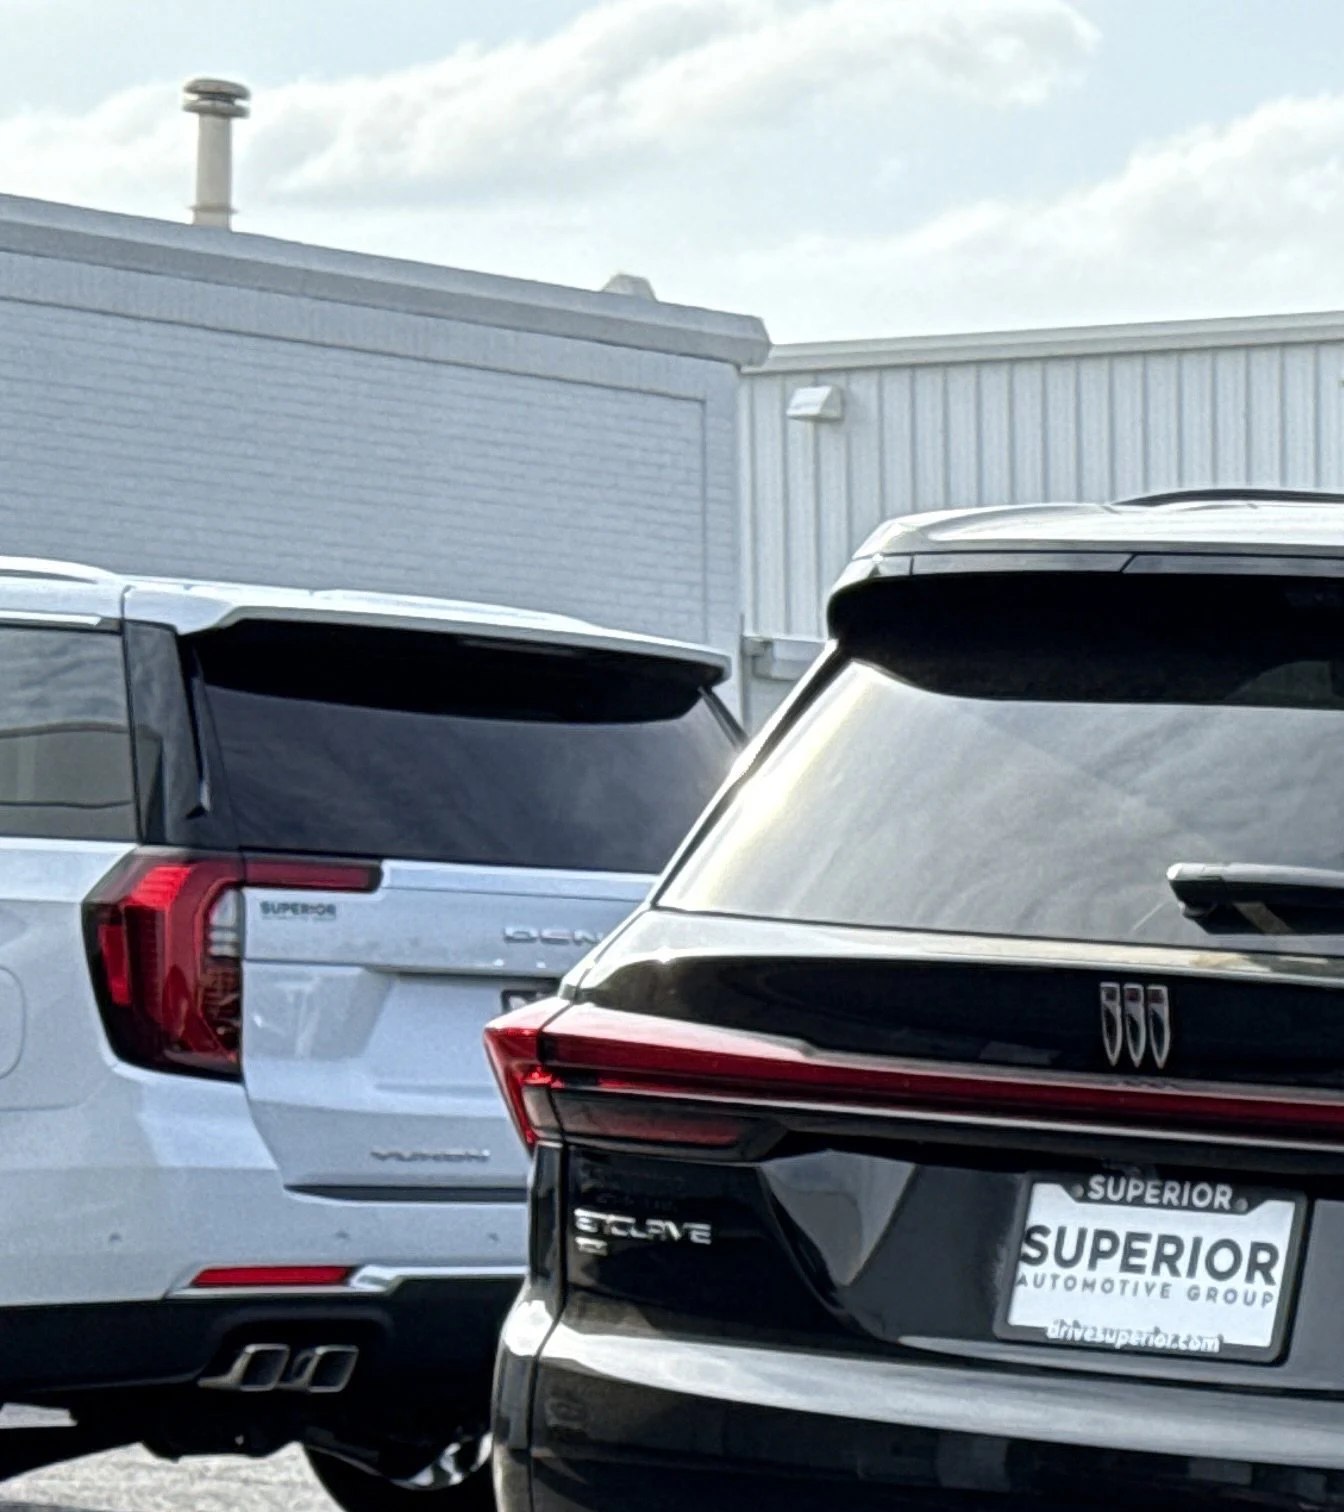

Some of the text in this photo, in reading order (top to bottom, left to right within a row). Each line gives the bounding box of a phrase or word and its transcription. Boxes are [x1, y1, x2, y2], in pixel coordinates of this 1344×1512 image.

[1087, 1173, 1234, 1211] SUPERIOR
[1018, 1224, 1280, 1287] SUPERIOR
[1015, 1271, 1275, 1309] AUTOMOTIVE GROUP
